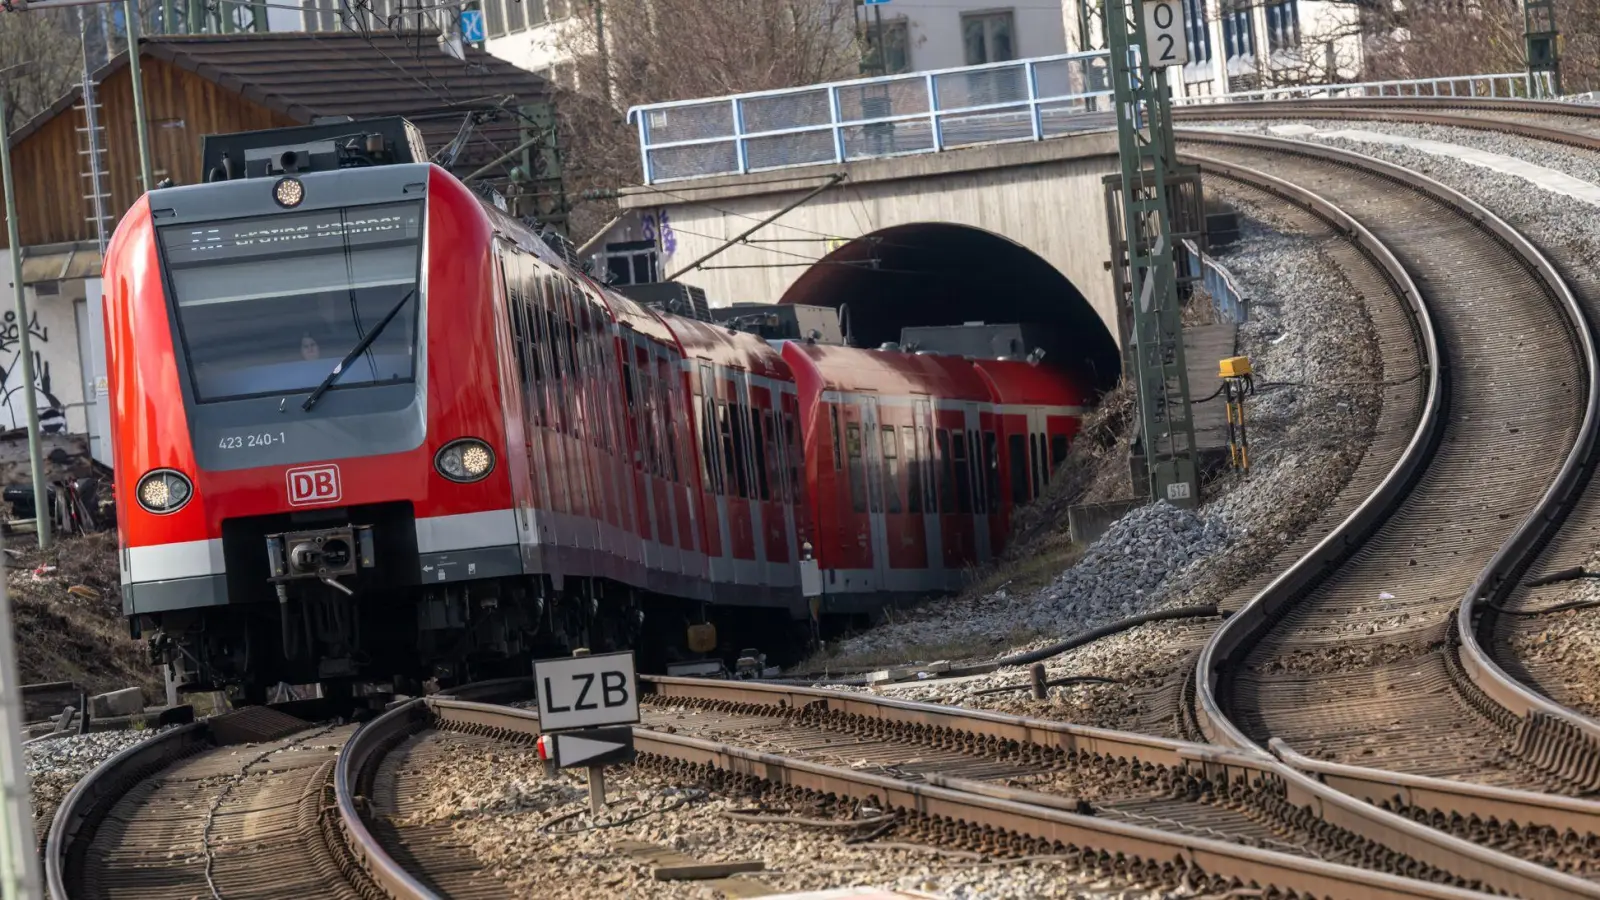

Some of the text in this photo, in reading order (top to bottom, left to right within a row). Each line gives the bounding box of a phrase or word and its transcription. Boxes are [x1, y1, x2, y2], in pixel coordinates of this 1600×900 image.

[1154, 3, 1173, 29] 0
[1157, 34, 1176, 61] 2
[218, 432, 285, 449] 423 240-1
[291, 470, 336, 500] DB
[544, 671, 628, 713] LZB
